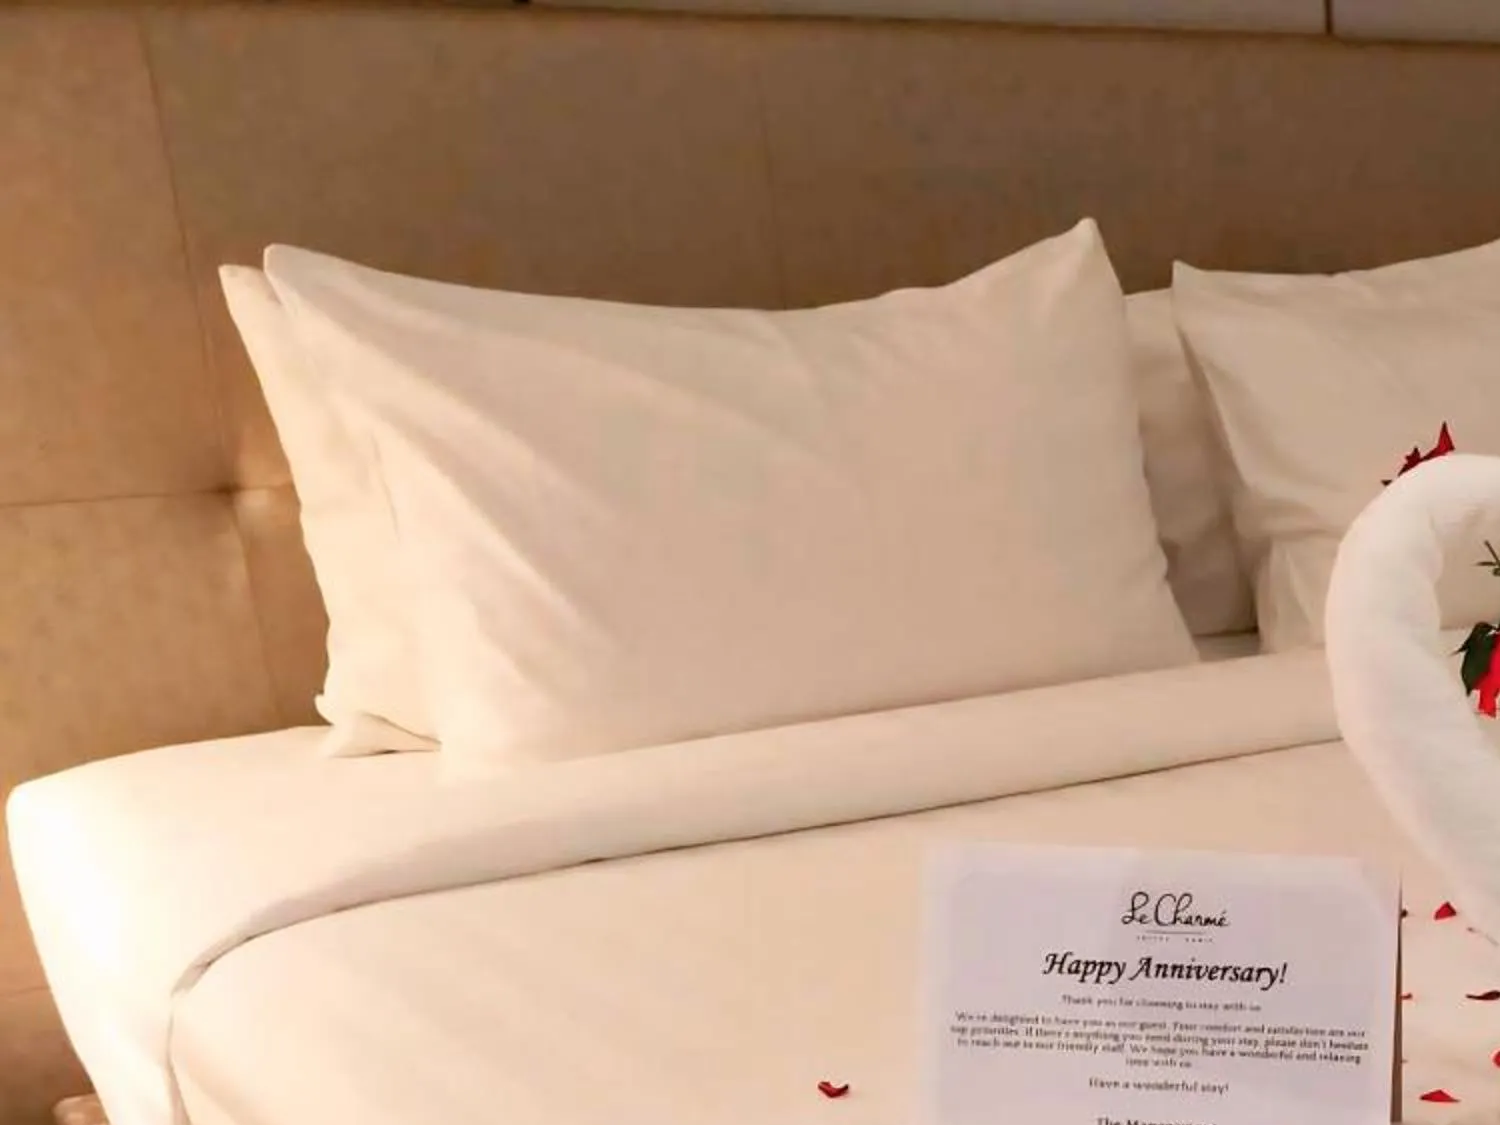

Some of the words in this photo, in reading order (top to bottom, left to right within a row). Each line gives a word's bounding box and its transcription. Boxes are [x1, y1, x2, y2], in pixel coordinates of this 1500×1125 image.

[1120, 890, 1152, 926] Le
[1153, 892, 1231, 928] Charmé
[1042, 950, 1127, 985] Happy
[1128, 954, 1288, 992] Anniversary!
[1062, 994, 1093, 1006] Thank
[1097, 998, 1118, 1009] you
[1119, 997, 1134, 1007] for
[1185, 1001, 1198, 1010] to
[1222, 1001, 1247, 1012] with
[1041, 1014, 1053, 1025] to
[1054, 1016, 1080, 1026] have
[1082, 1019, 1103, 1029] you
[1244, 1023, 1266, 1034] and
[1328, 1028, 1345, 1036] are
[1122, 1034, 1143, 1043] you
[957, 1037, 970, 1048] to
[971, 1038, 1001, 1048] reach
[1023, 1039, 1036, 1050] to
[1057, 1041, 1099, 1055] friendly
[1129, 1043, 1149, 1054] We
[1200, 1046, 1226, 1057] have
[1238, 1049, 1294, 1060] wonderful
[1295, 1050, 1318, 1061] and
[1319, 1051, 1361, 1065] relaxing
[1151, 1058, 1178, 1068] with
[1088, 1076, 1121, 1090] Have
[1132, 1079, 1199, 1093] wonderful
[1200, 1082, 1230, 1096] stay!
